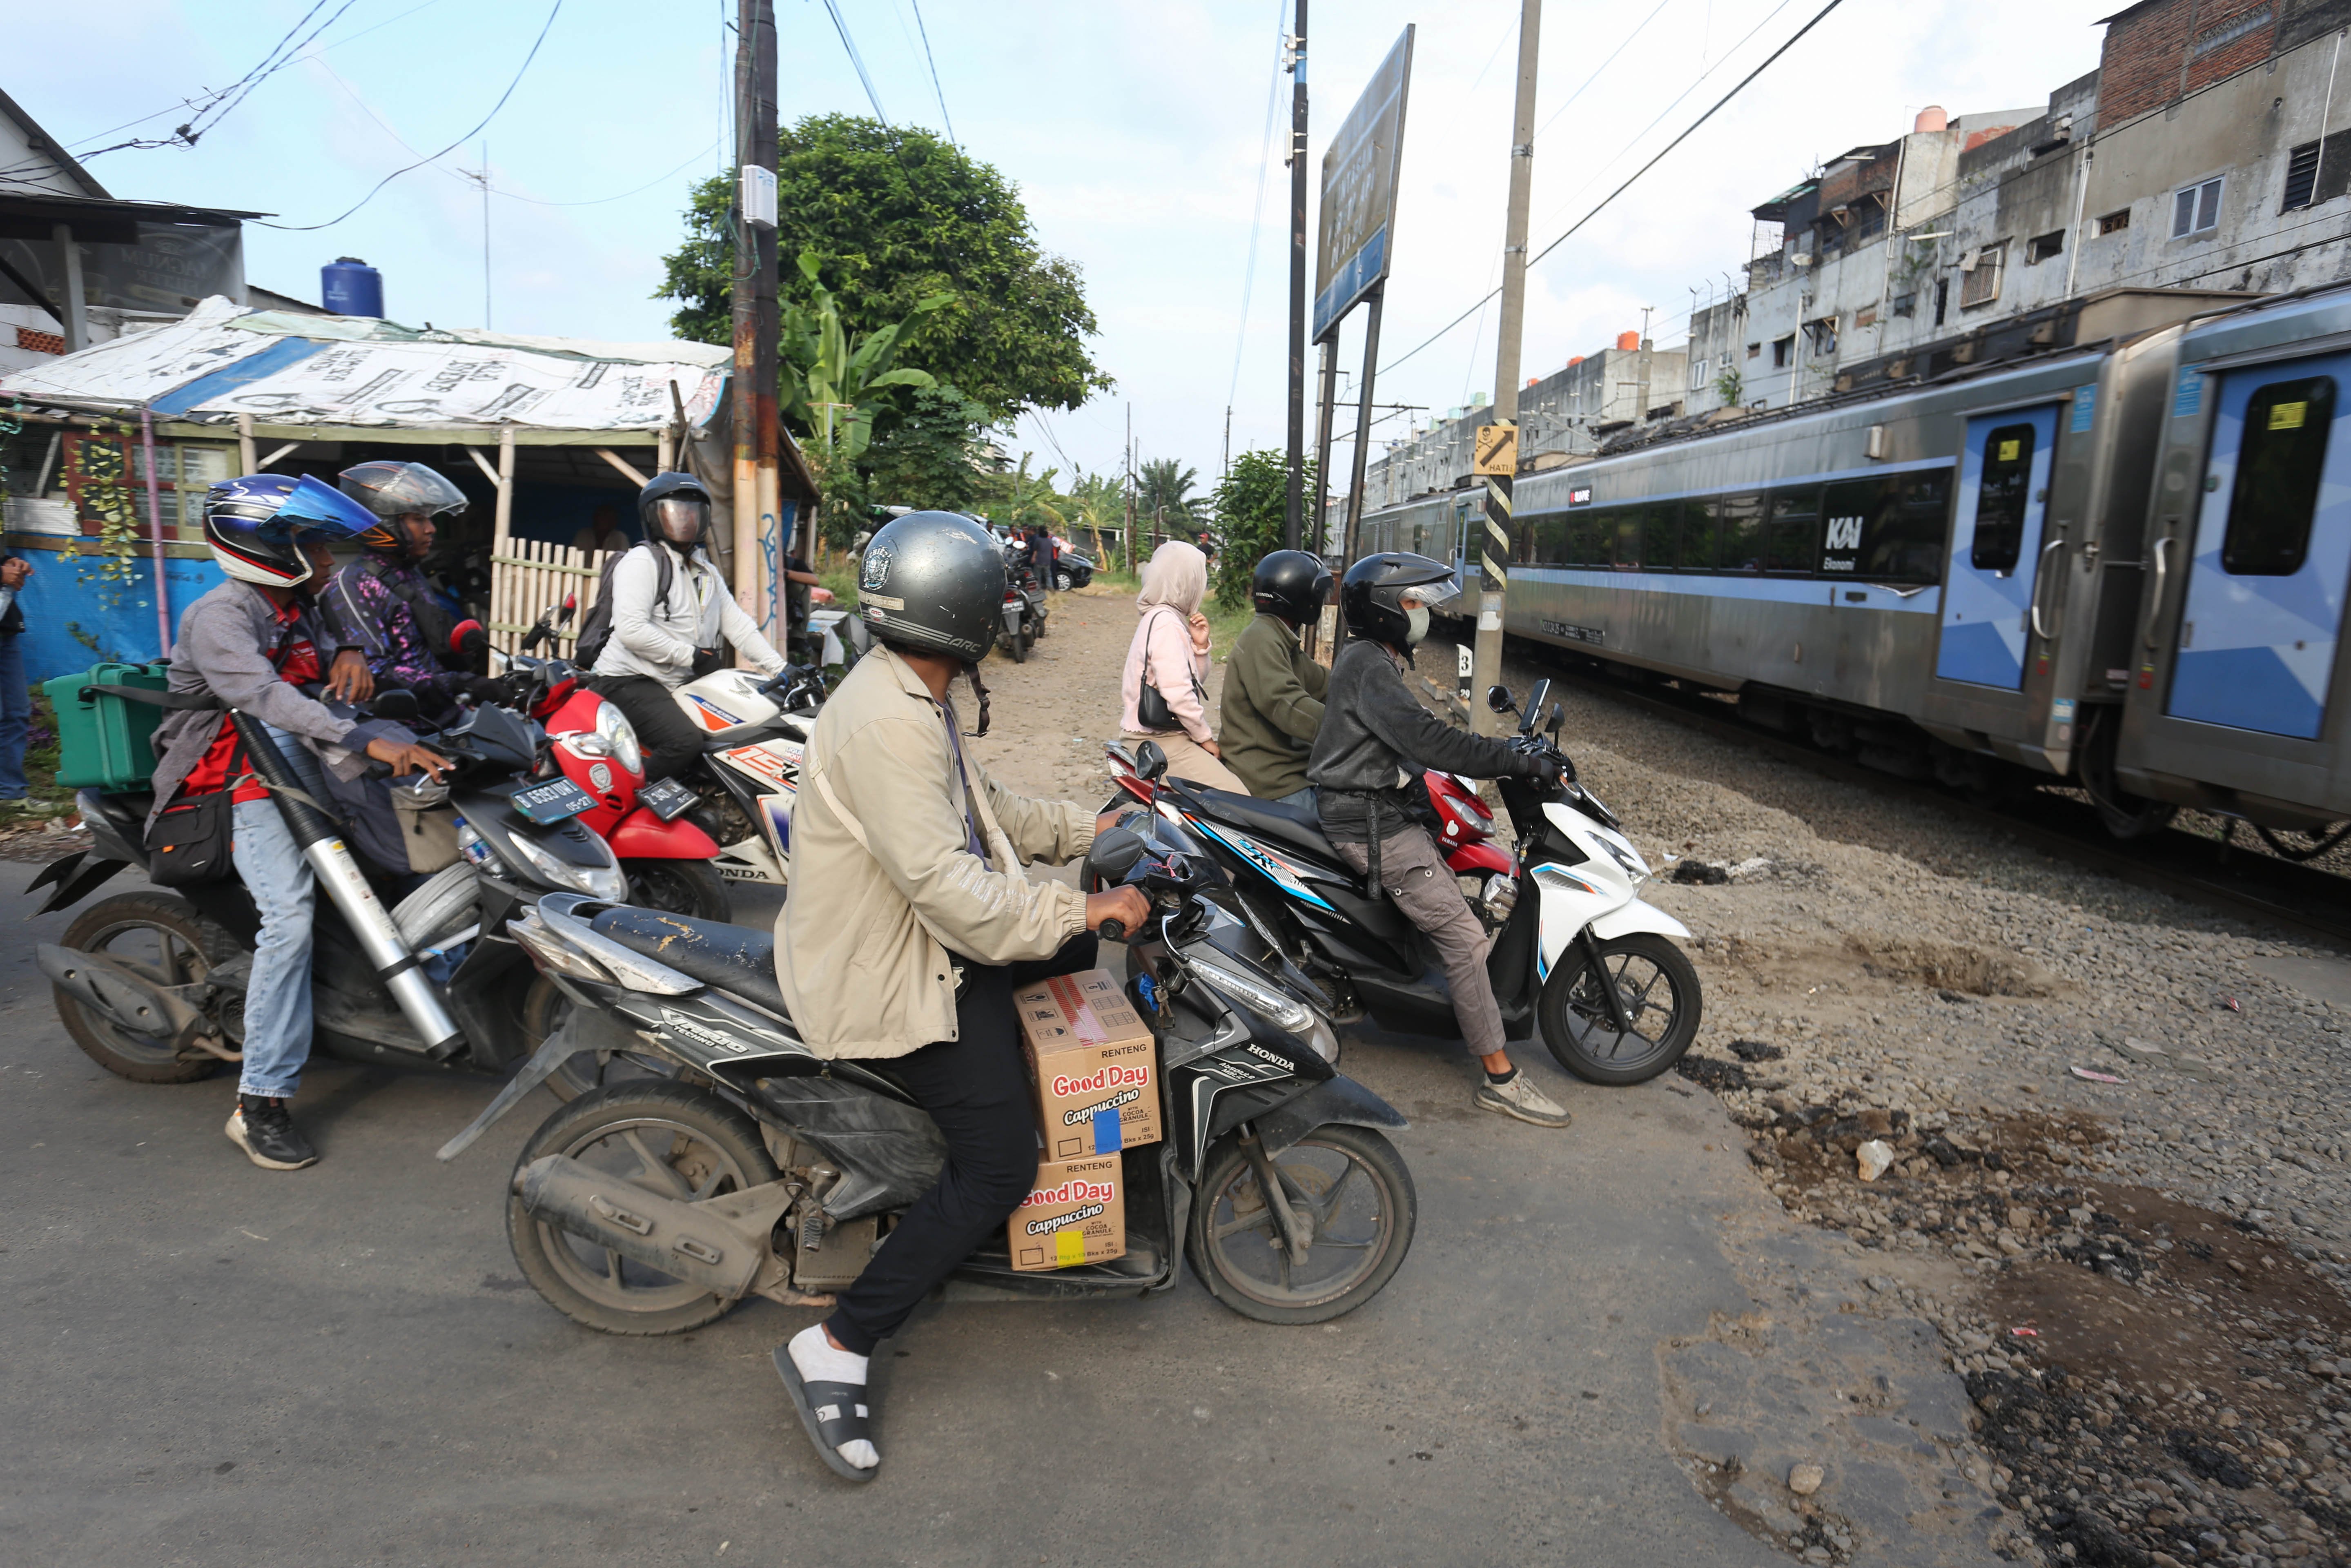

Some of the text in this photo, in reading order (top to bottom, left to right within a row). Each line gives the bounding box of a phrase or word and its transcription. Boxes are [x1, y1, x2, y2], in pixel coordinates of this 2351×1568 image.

[1825, 516, 1863, 549] KAI
[948, 638, 981, 653] ARC
[1461, 655, 1469, 671] 3
[515, 795, 532, 808] B
[526, 786, 560, 804] 6593
[644, 795, 657, 805] Z
[1442, 836, 1458, 847] YAMAHA
[1370, 882, 1378, 897] Klein
[660, 1009, 749, 1054] VARIO
[673, 1025, 716, 1047] TECHNO
[1101, 1044, 1147, 1058] RENTENG
[1247, 1043, 1295, 1071] HONDA
[1218, 1062, 1256, 1080] Absolute
[1052, 1065, 1149, 1097] Good Day
[1063, 1088, 1140, 1126] Cappuccino
[1122, 1109, 1144, 1118] COCOA
[1119, 1113, 1148, 1123] GRANULE
[1067, 1161, 1112, 1173] RENTENG
[1073, 1180, 1114, 1203] Day
[1026, 1203, 1103, 1235] Cappuccino
[1082, 1228, 1112, 1236] GRANULE
